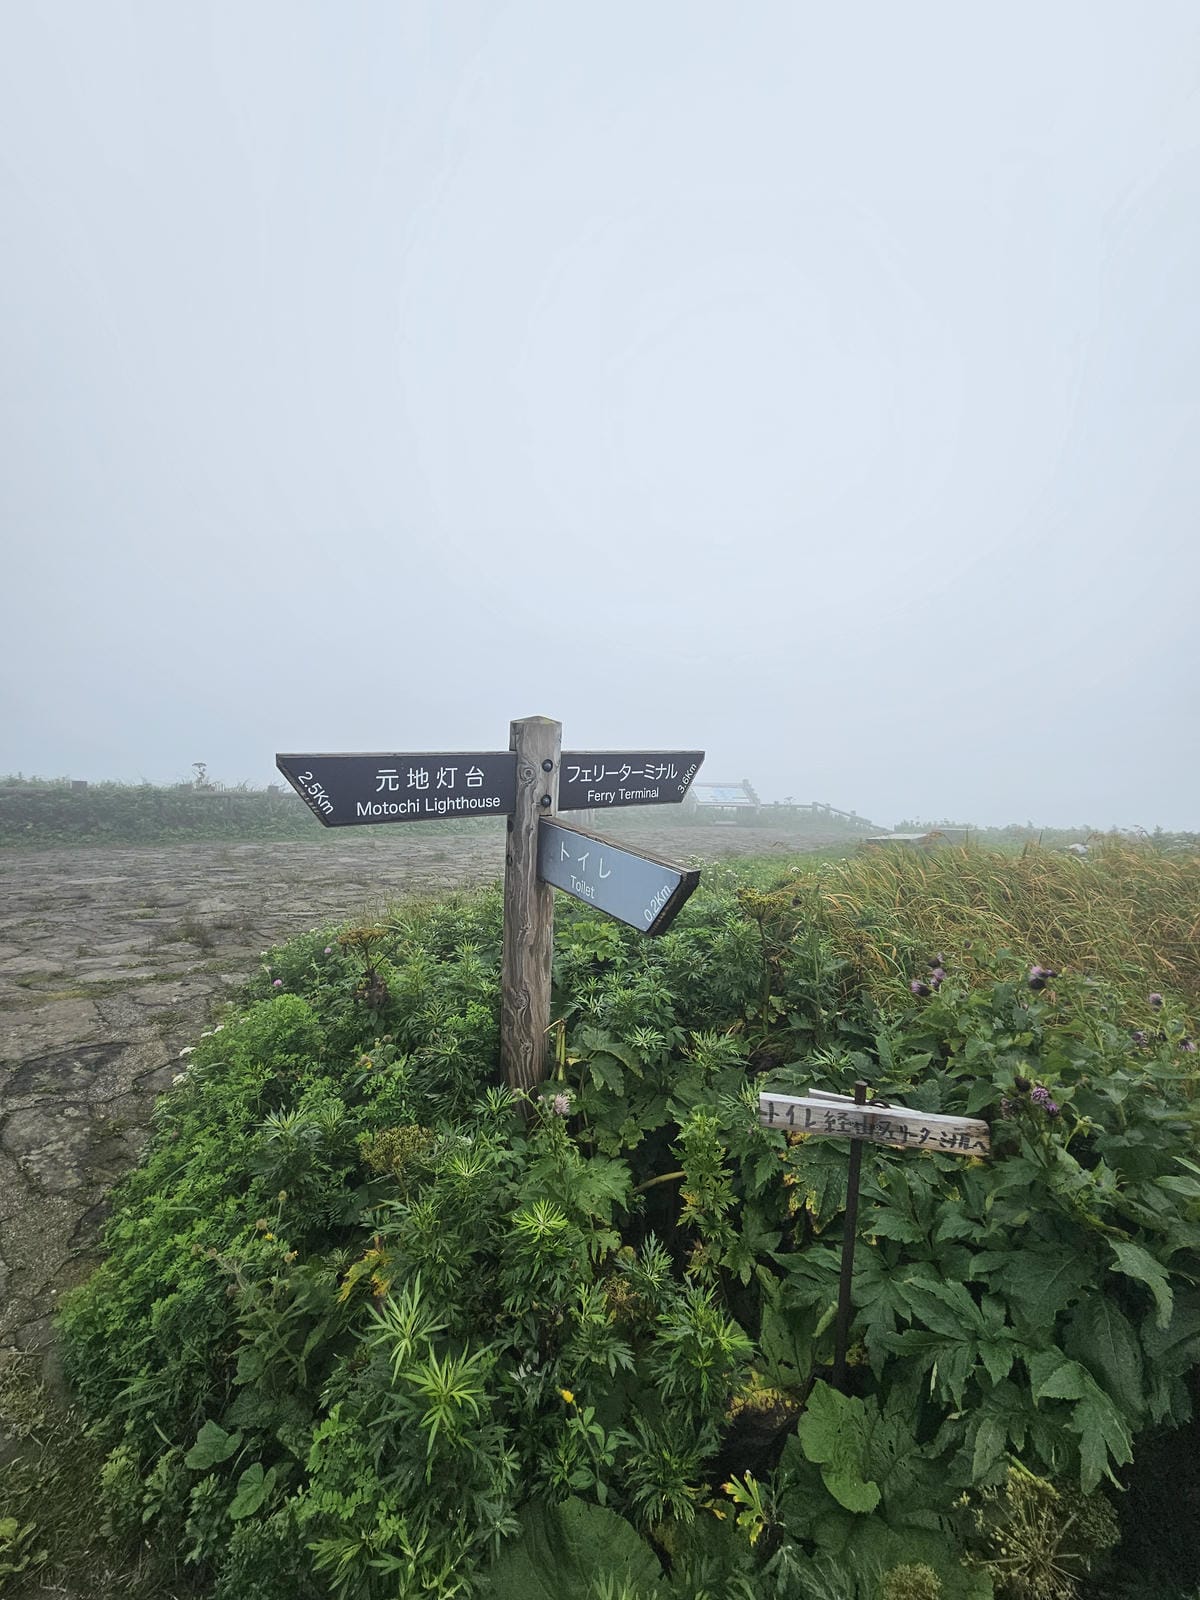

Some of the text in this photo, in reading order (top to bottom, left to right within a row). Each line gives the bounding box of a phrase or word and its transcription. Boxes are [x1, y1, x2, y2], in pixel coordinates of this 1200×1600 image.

[374, 766, 486, 792] 元地灯台
[566, 762, 678, 784] フェリーターミナル
[677, 762, 698, 795] 3.6Km
[297, 770, 334, 815] 2.5Km
[356, 794, 501, 817] Motochi Lighthouse
[587, 786, 660, 804] Ferry Terminal
[560, 840, 612, 879] トイレ
[570, 875, 595, 899] Toilet
[643, 884, 671, 922] 0.2Km
